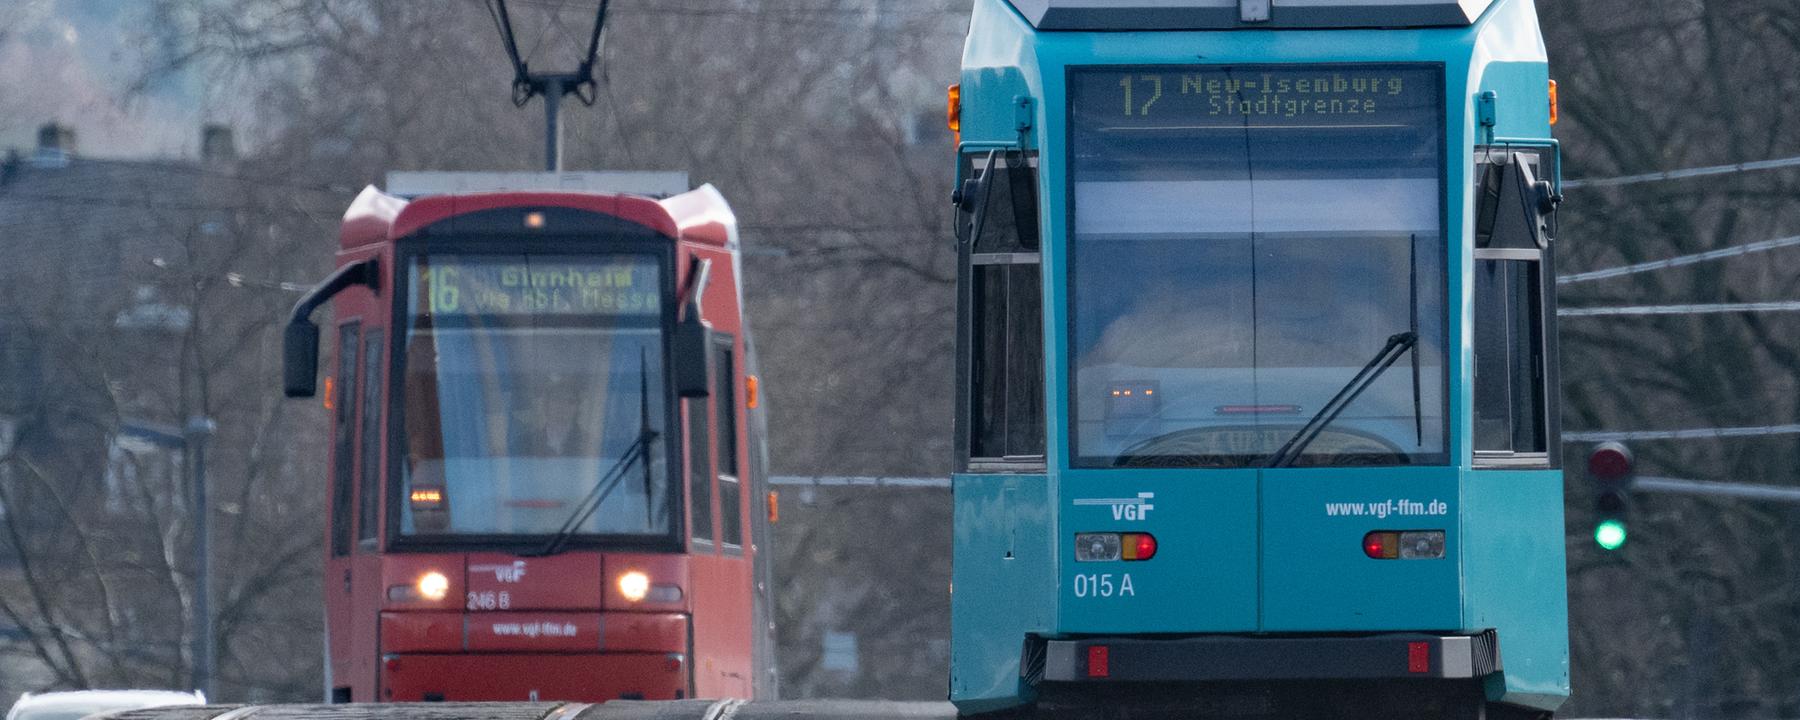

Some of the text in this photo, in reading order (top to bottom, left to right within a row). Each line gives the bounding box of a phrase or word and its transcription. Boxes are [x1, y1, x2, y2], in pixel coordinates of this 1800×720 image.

[1119, 75, 1162, 115] 17
[1181, 74, 1402, 95] Neu-Isenburg
[1208, 94, 1377, 117] Stadtgrenze
[422, 265, 460, 312] 16
[1111, 492, 1154, 521] VGF
[1325, 498, 1448, 518] www.vgf-ffm.de
[1074, 573, 1135, 597] 015 A
[466, 591, 496, 610] 246
